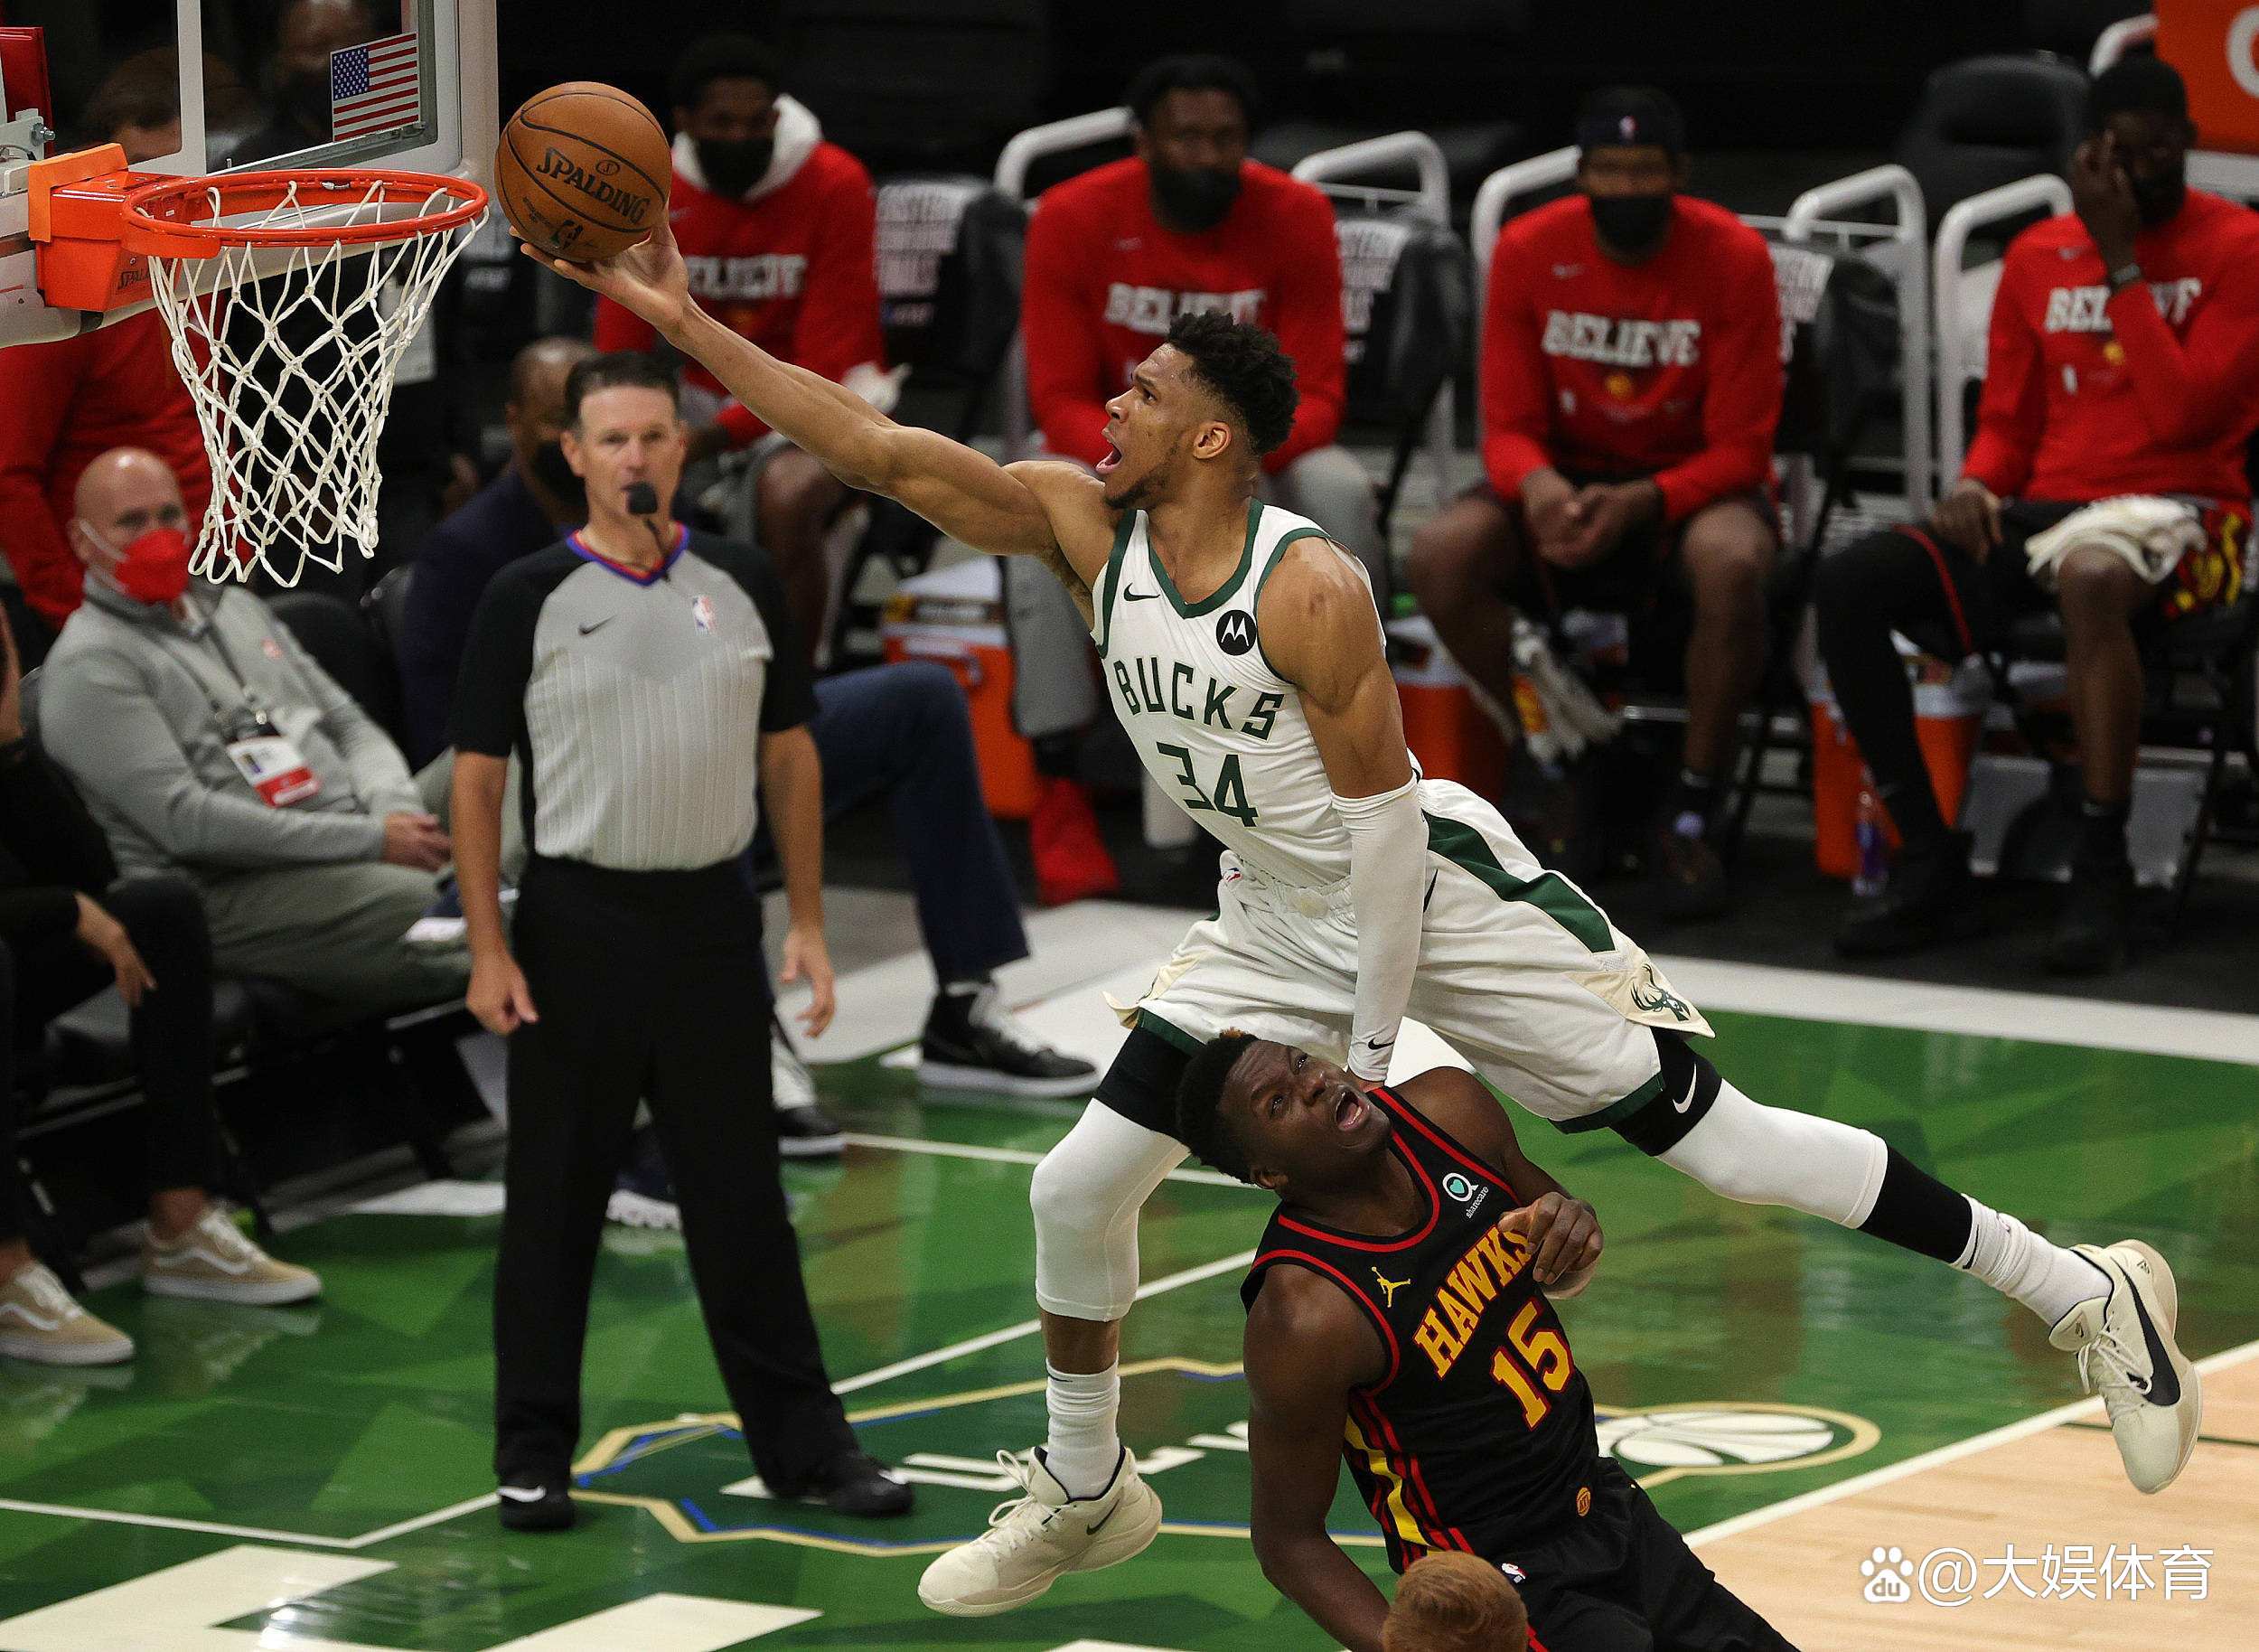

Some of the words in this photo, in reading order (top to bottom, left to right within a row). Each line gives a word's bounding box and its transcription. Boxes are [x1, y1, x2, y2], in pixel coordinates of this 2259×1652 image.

[536, 146, 651, 225] SPALDING
[1541, 308, 1702, 367] BELIEVE
[1112, 656, 1285, 741] BUCKS
[1156, 741, 1260, 828] 34
[1466, 1186, 1490, 1219] sharecare
[1412, 1225, 1533, 1381] HAWKS
[1490, 1298, 1576, 1431] 15
